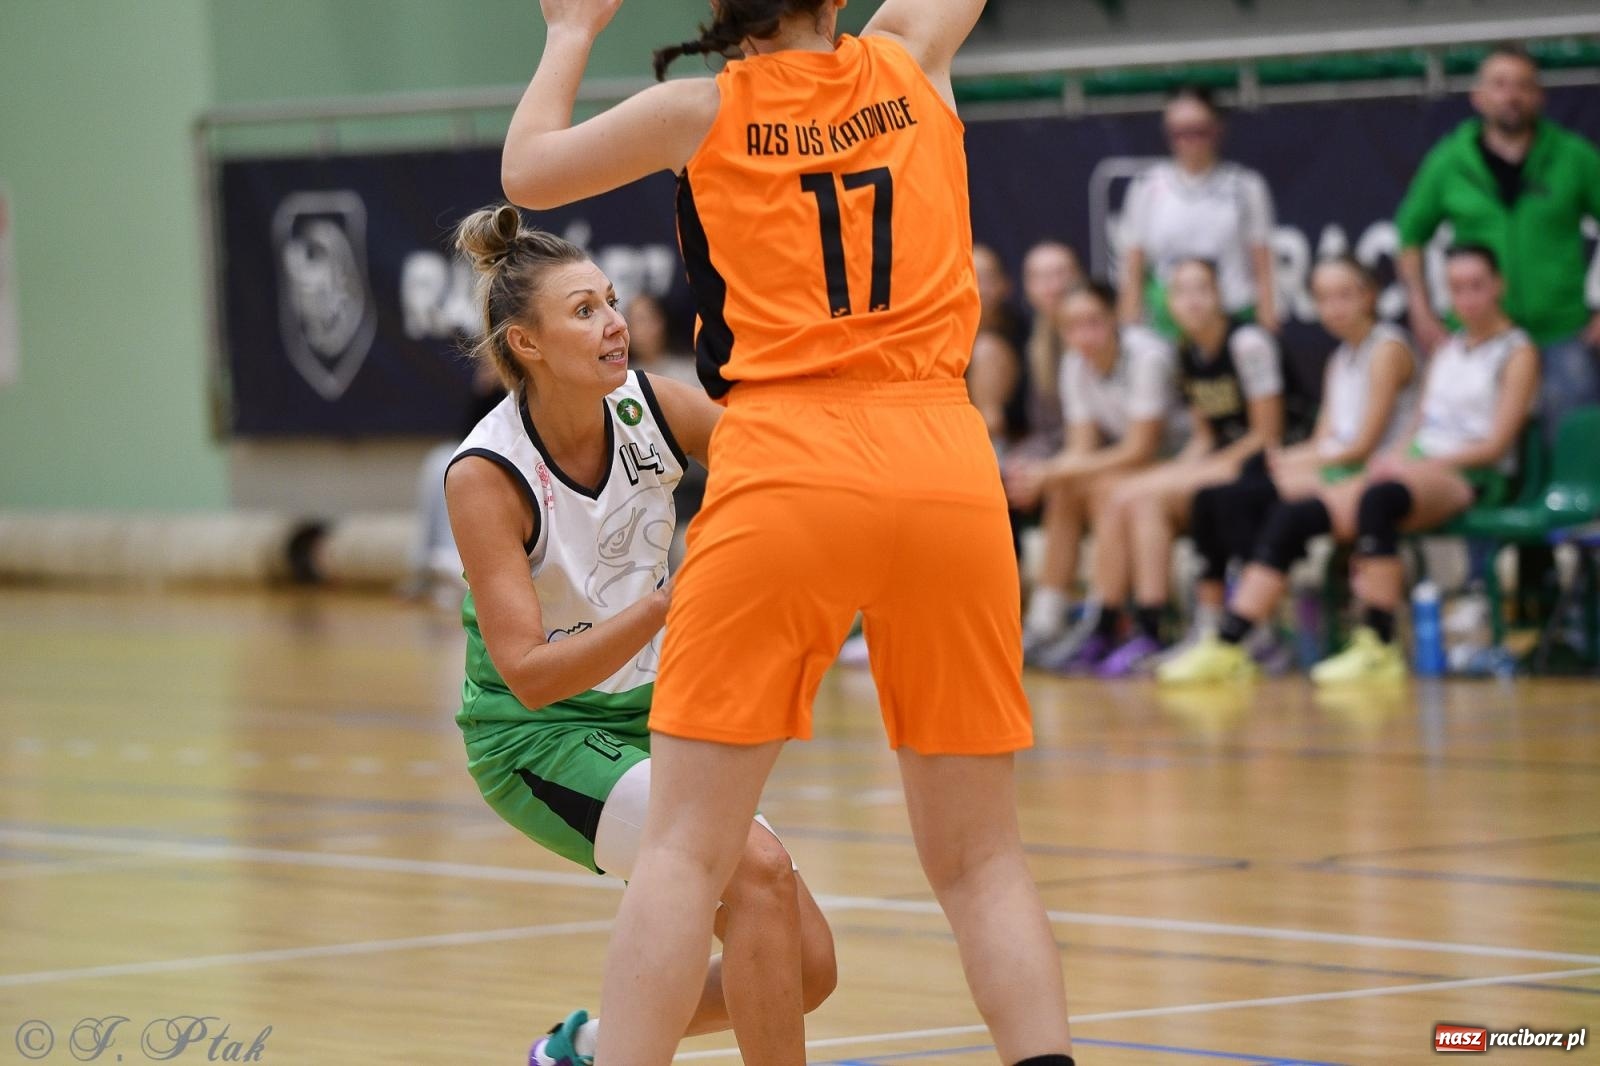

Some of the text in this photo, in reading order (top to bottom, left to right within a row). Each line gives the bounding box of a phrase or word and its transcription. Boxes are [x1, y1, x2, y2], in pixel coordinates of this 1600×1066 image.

[747, 123, 789, 156] AZS
[795, 119, 824, 156] UŚ
[799, 166, 893, 319] 17
[619, 442, 665, 486] 14
